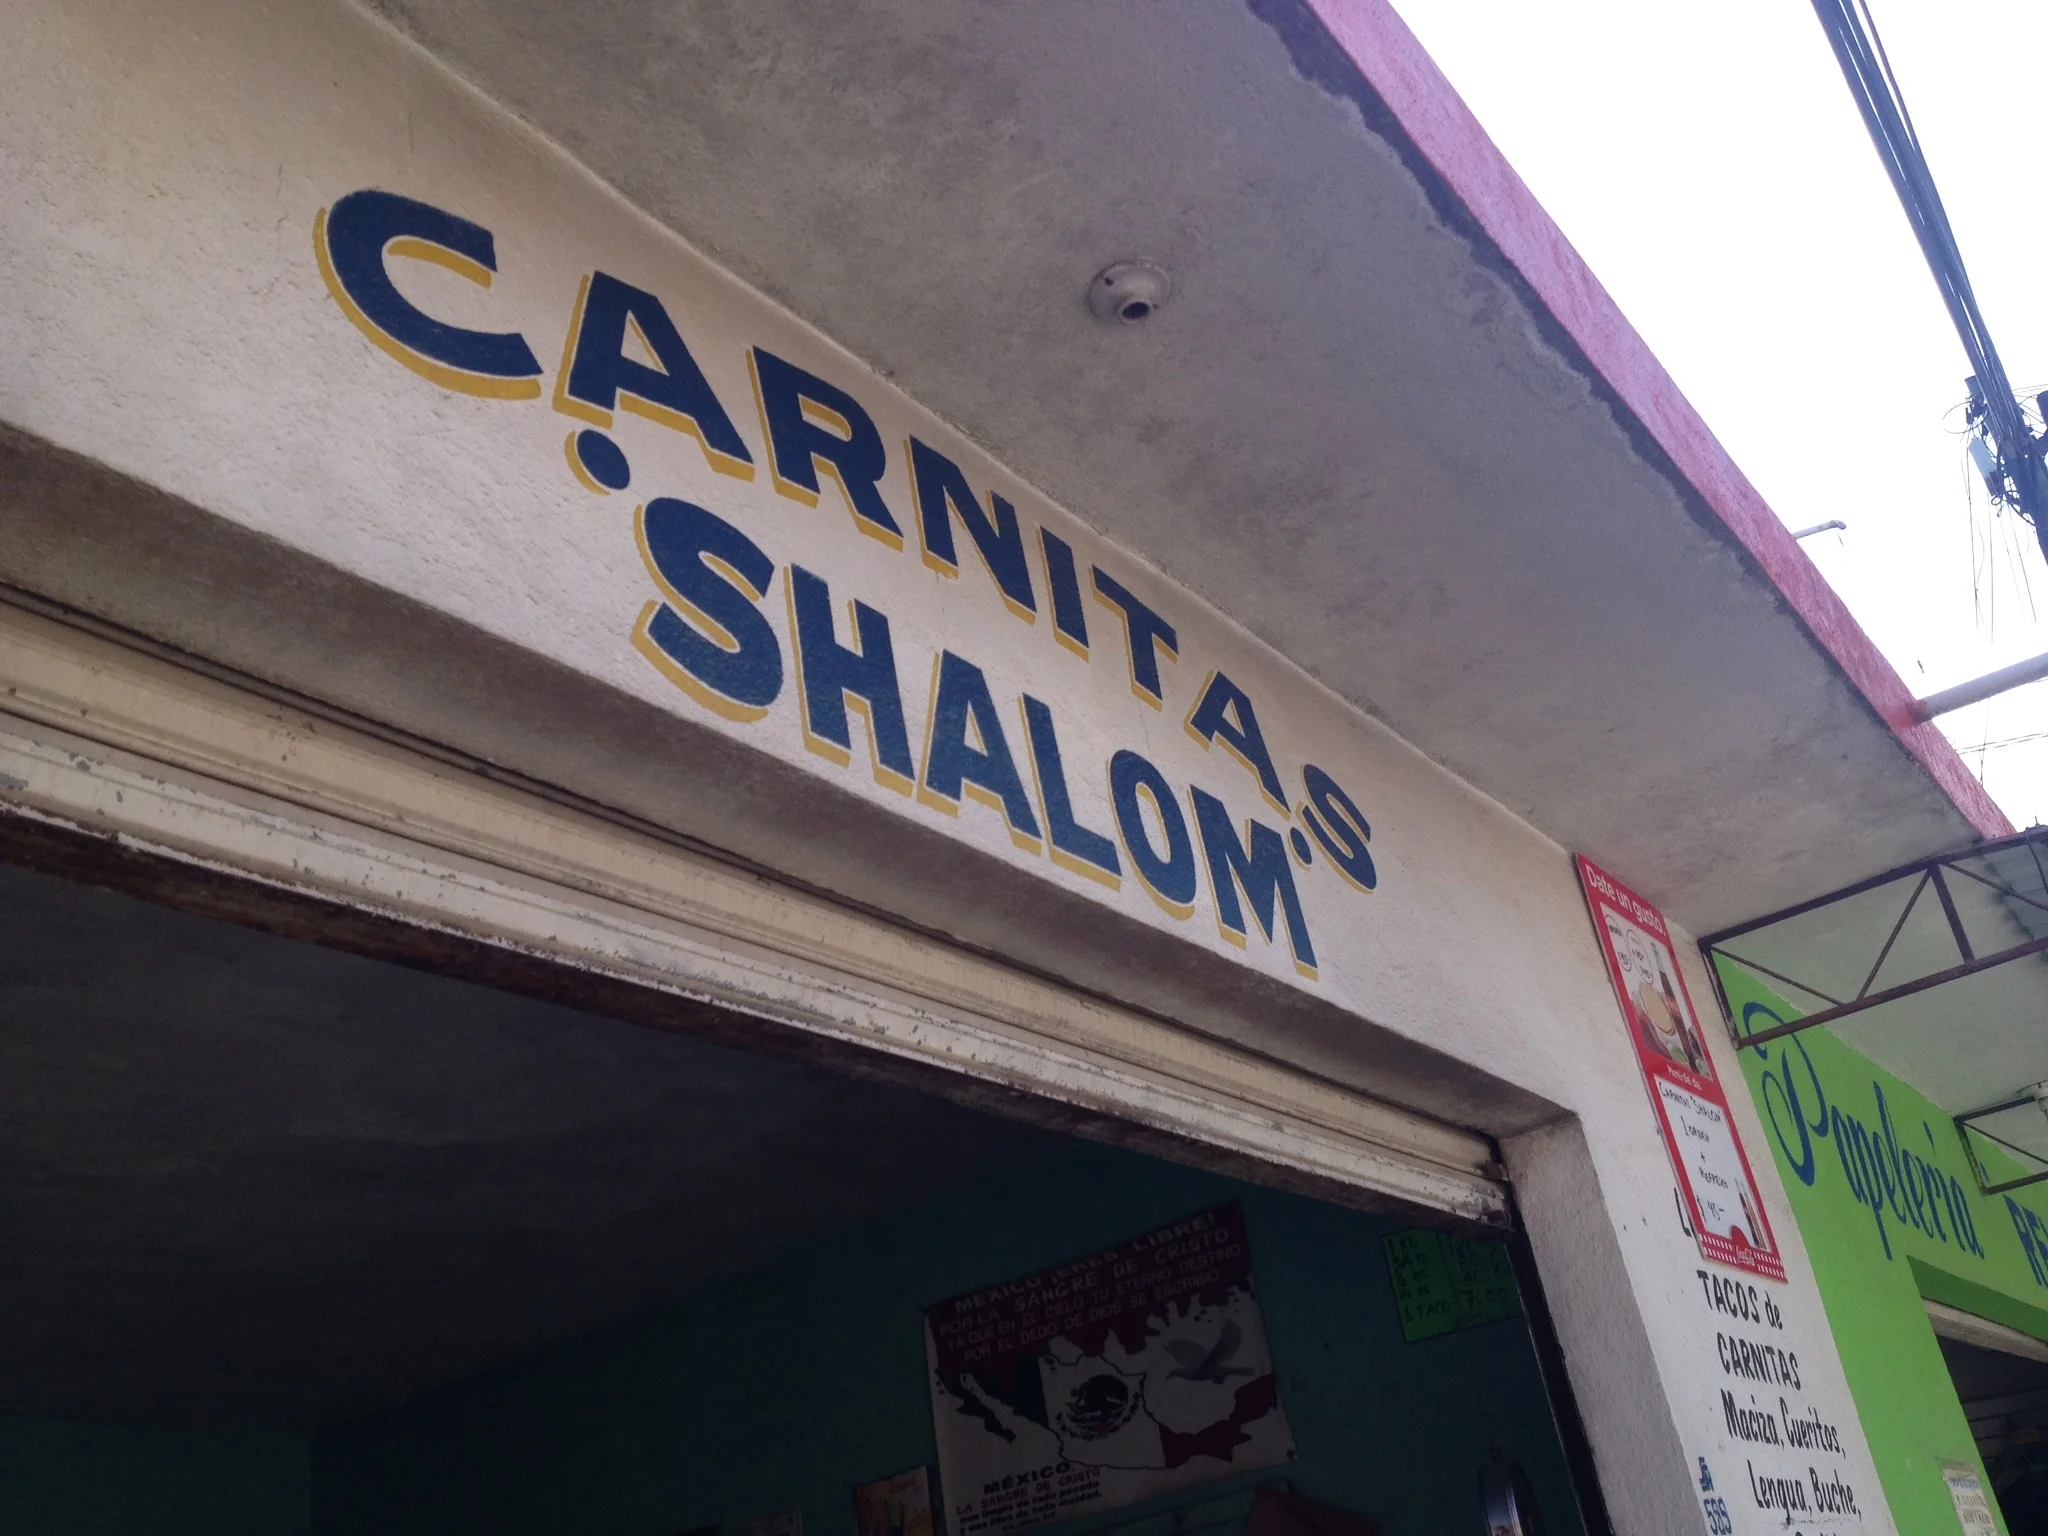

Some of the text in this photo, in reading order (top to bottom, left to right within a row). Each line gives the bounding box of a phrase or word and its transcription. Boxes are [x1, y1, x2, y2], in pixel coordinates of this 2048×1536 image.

[630, 496, 1319, 982] SHALOM
[1585, 864, 1667, 937] Date un gusto.
[1131, 1213, 1216, 1252] LIBRE!
[939, 1228, 1230, 1338] POR LA SANGRE DE CRISTO
[946, 1243, 1241, 1352] YA QUE EN EL CIELO TU ETERNO DESTINO
[1416, 1301, 1449, 1319] TACO
[1696, 1269, 1783, 1330] TACOS de
[964, 1344, 991, 1364] POR
[998, 1336, 1014, 1354] EL
[1020, 1321, 1058, 1347] DEDO
[1064, 1313, 1084, 1332] DE
[1089, 1299, 1122, 1323] DIOS
[1129, 1292, 1148, 1310] SE
[1716, 1332, 1801, 1391] CARNITAS
[1720, 1388, 1846, 1458] Maciza, Cueritos,
[956, 1503, 973, 1515] LA
[980, 1487, 1029, 1508] SANGRE
[1747, 1459, 1862, 1526] Lengua, Buche,
